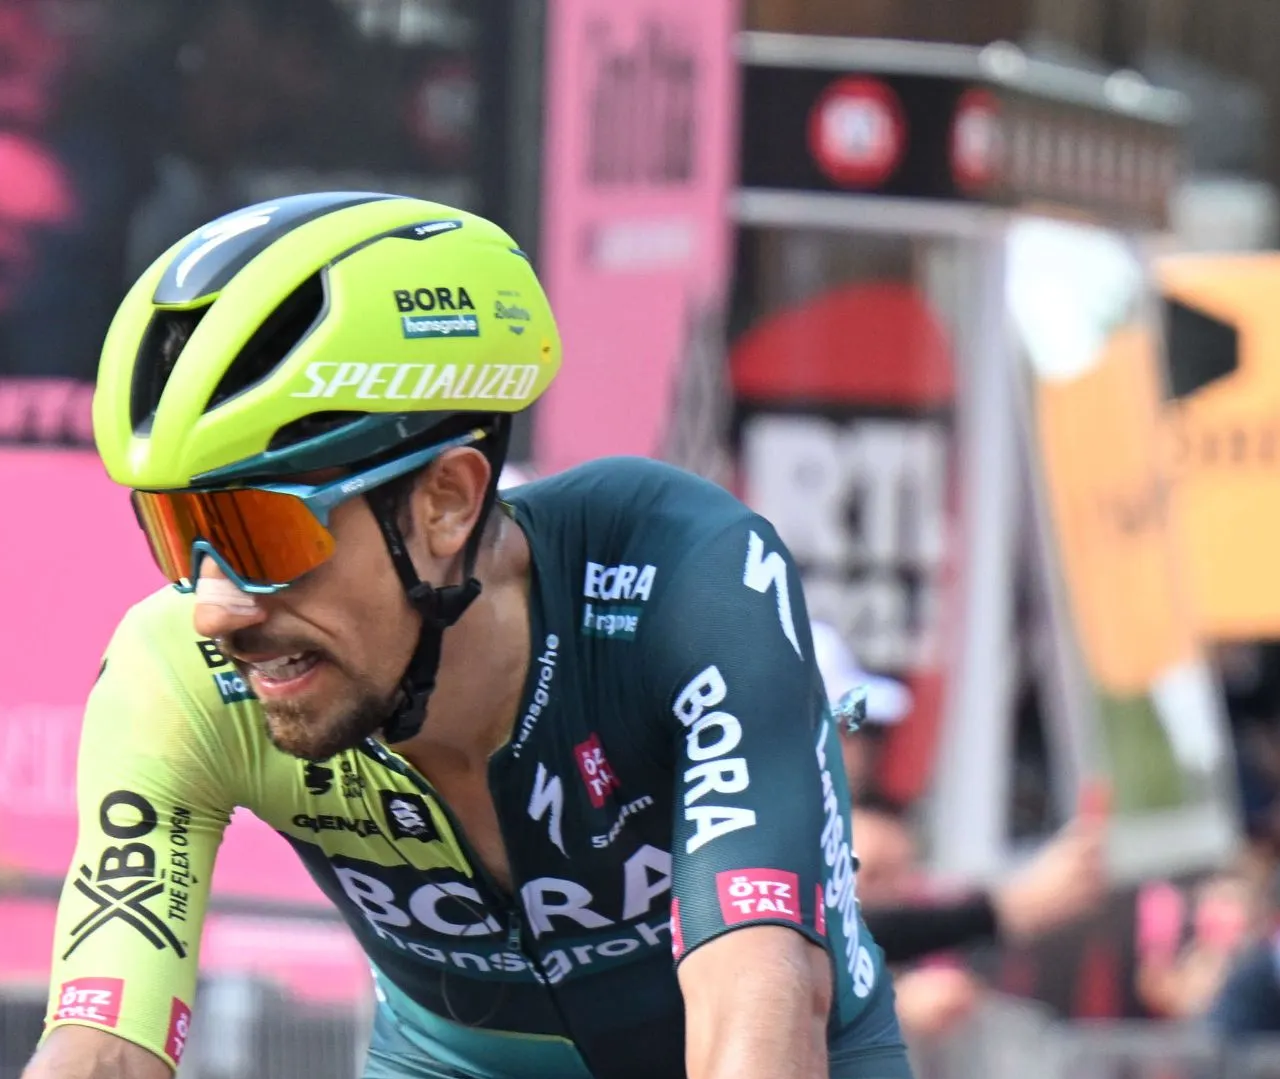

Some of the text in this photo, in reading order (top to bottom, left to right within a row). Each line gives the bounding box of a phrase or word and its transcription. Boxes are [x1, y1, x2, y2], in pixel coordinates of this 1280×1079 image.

[393, 287, 476, 313] BORA
[403, 314, 477, 334] hansgrohe
[289, 361, 540, 399] SPECIALIZED
[671, 664, 756, 855] BORA
[62, 790, 187, 961] XBO
[168, 806, 192, 922] THE FLEX OVEN
[728, 875, 792, 898] ÖTZ
[731, 897, 794, 915] TAL
[372, 918, 673, 985] hansgroh
[61, 986, 113, 1006] ÖTZ
